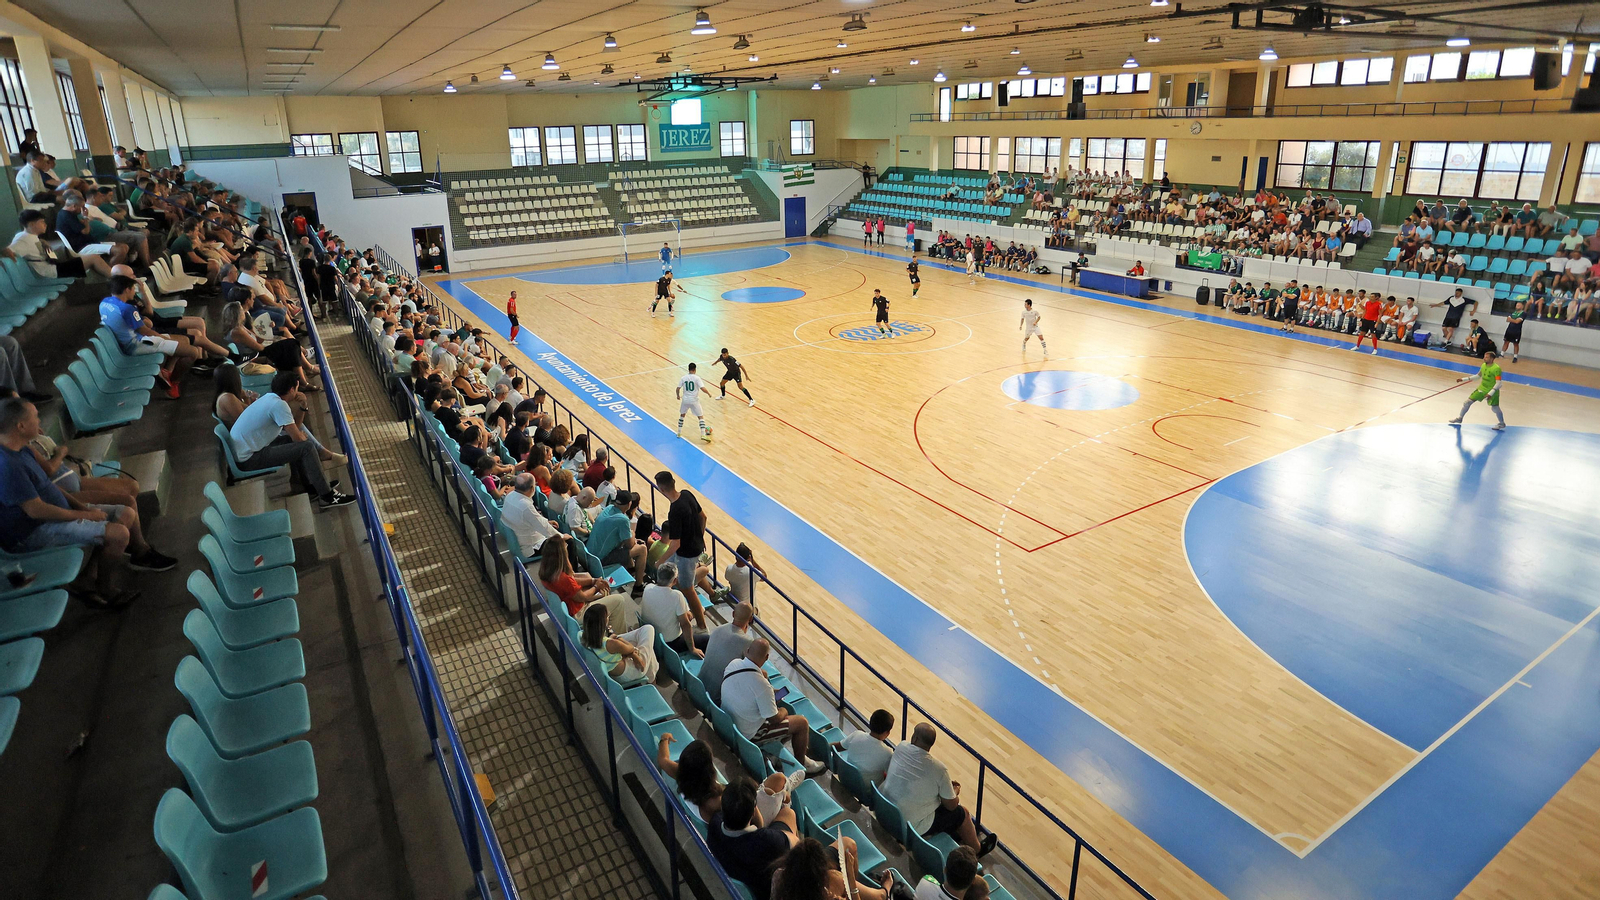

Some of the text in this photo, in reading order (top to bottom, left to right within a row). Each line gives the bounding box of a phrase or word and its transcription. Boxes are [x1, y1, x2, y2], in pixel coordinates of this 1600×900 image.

[661, 128, 710, 149] JEREZ
[537, 352, 643, 423] Ayuntamiento de Jerez
[684, 380, 695, 392] 10
